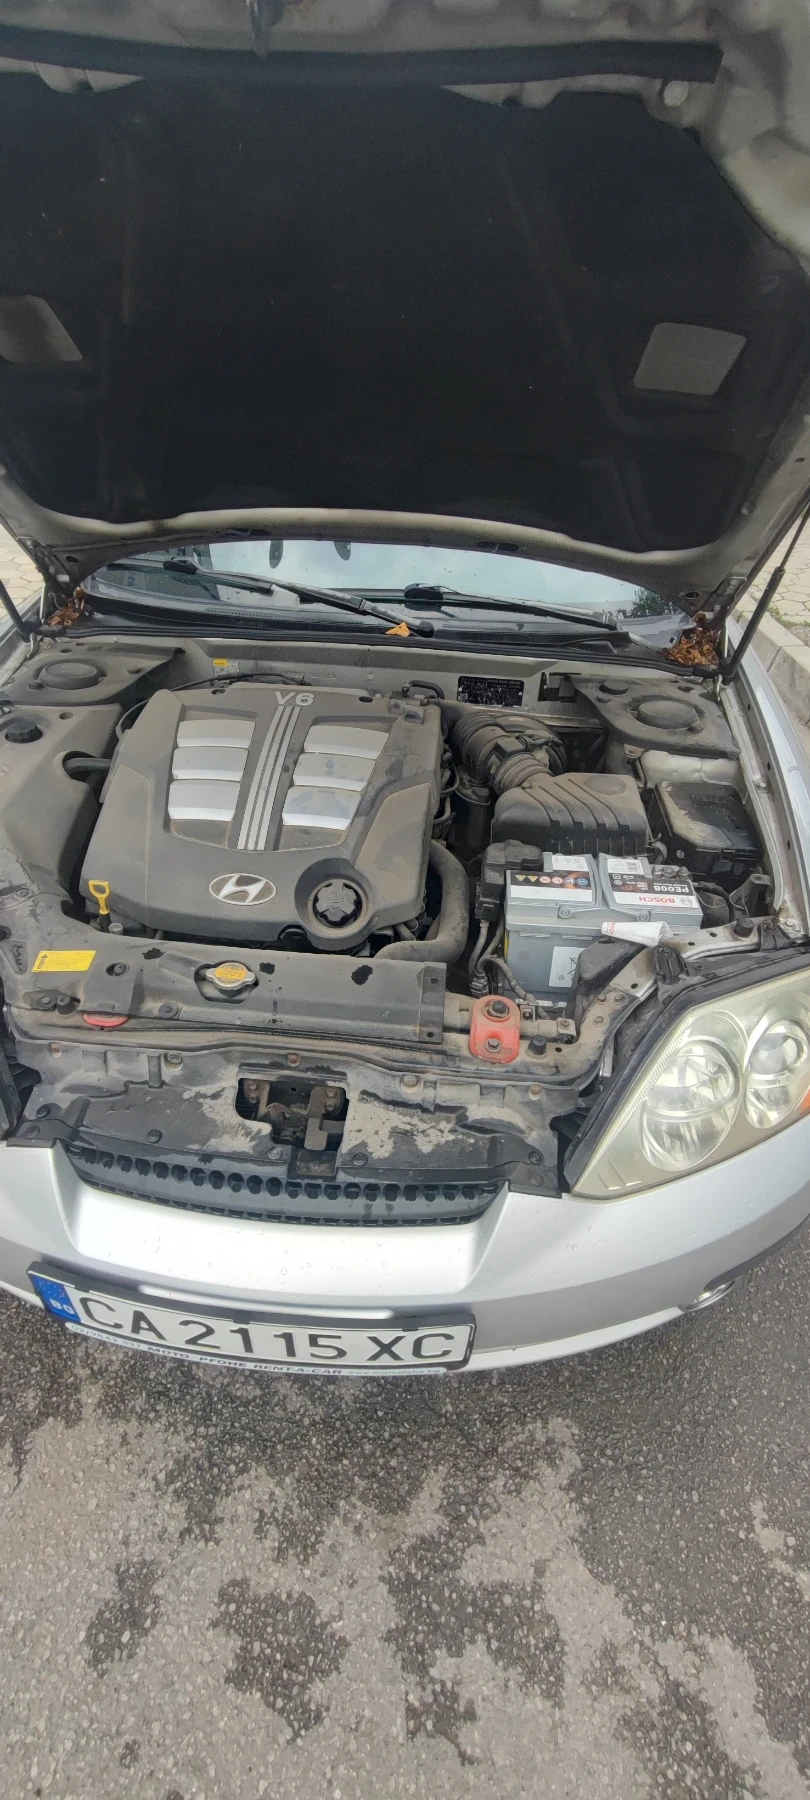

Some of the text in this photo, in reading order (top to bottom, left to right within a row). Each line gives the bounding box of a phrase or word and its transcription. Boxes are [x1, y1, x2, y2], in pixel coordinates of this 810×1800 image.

[275, 690, 315, 706] V6
[653, 885, 690, 893] PE008
[638, 896, 676, 904] BOSCH
[50, 1297, 76, 1315] BG
[178, 1319, 348, 1360] 2115
